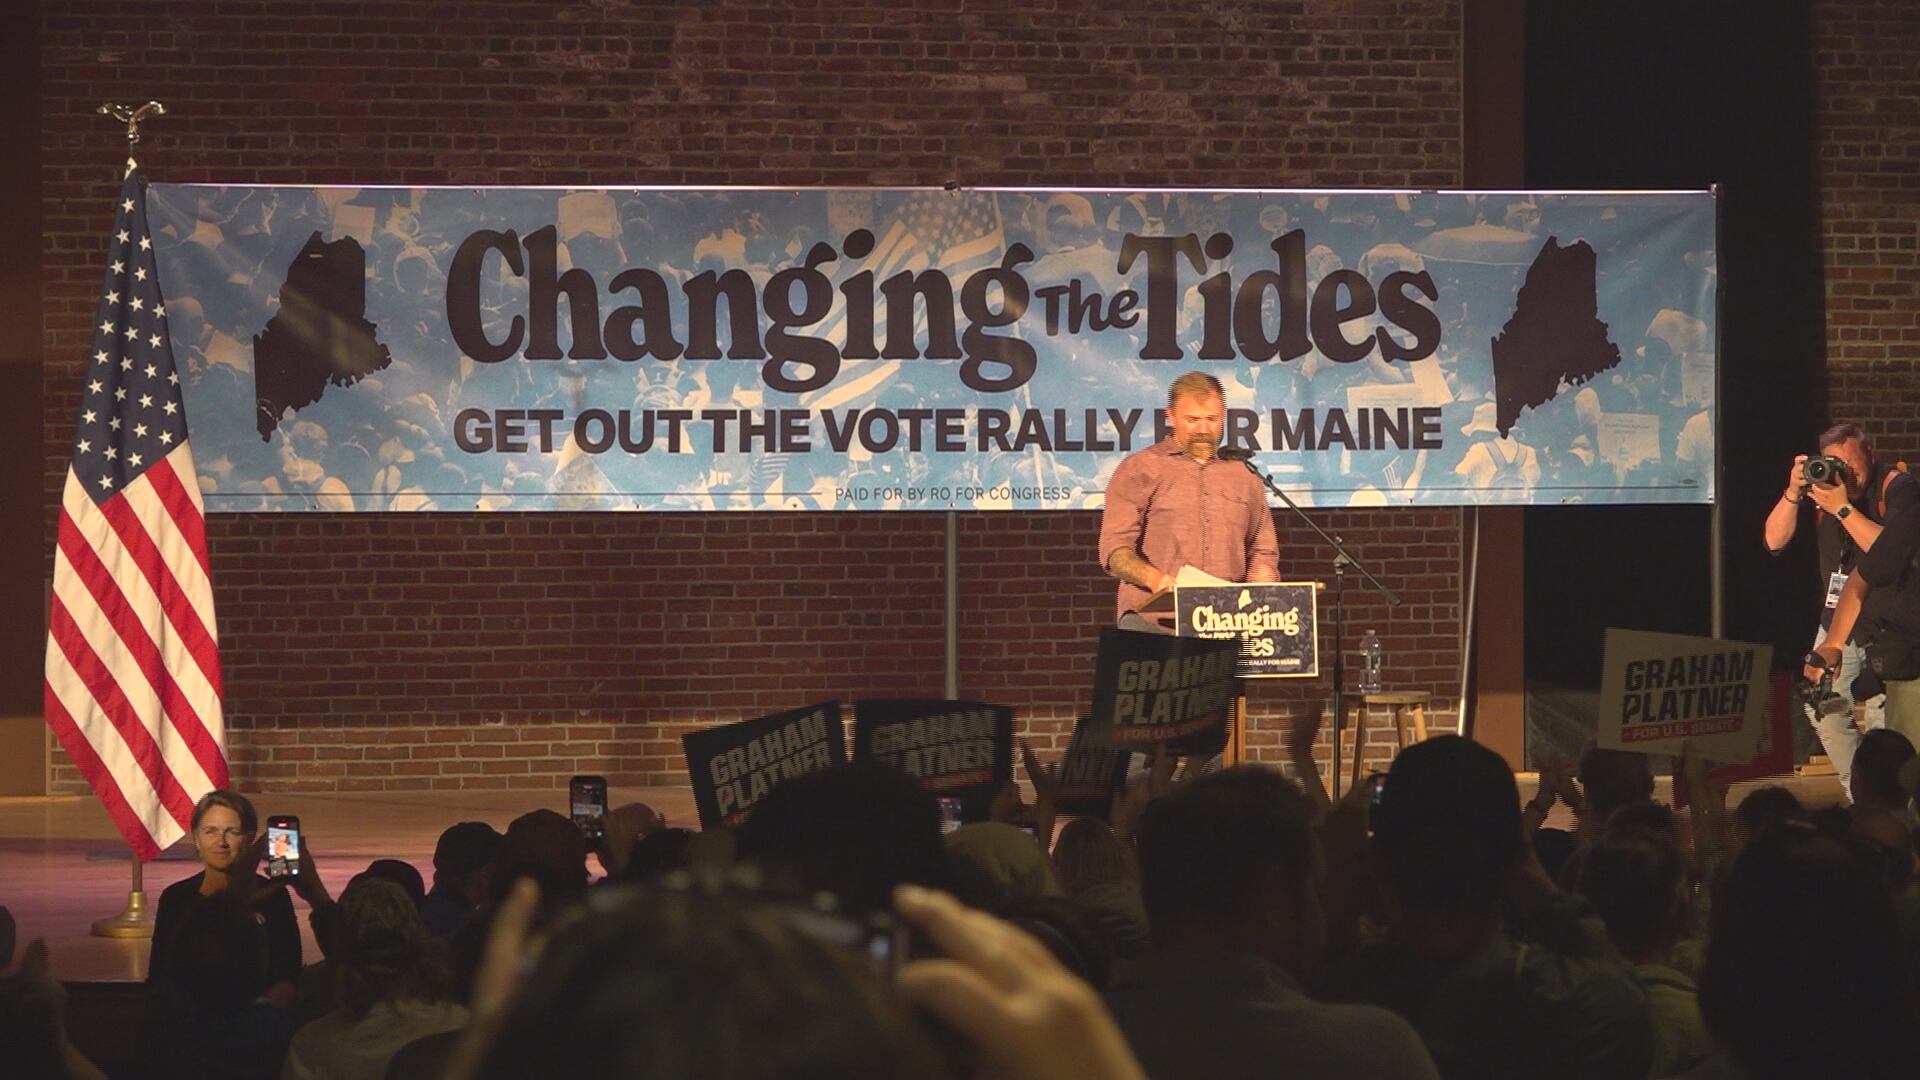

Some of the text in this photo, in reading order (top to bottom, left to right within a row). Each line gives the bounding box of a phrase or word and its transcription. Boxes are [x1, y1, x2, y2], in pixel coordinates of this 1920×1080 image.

[445, 224, 1442, 393] Changing The Tides
[454, 409, 564, 453] GET
[572, 409, 694, 454] OUT
[701, 410, 811, 454] THE
[820, 408, 967, 453] VOTE
[978, 408, 1143, 452] RALLY
[1271, 407, 1443, 451] MAINE
[835, 486, 1071, 501] PAID FOR BY RO FOR CONGRESS
[1192, 604, 1300, 636] Changing
[1624, 650, 1754, 692] GRAHAM
[1622, 683, 1750, 725] PLATNER
[710, 710, 826, 785] GRAHAM
[871, 709, 998, 754] GRAHAM
[1631, 726, 1660, 740] FOR
